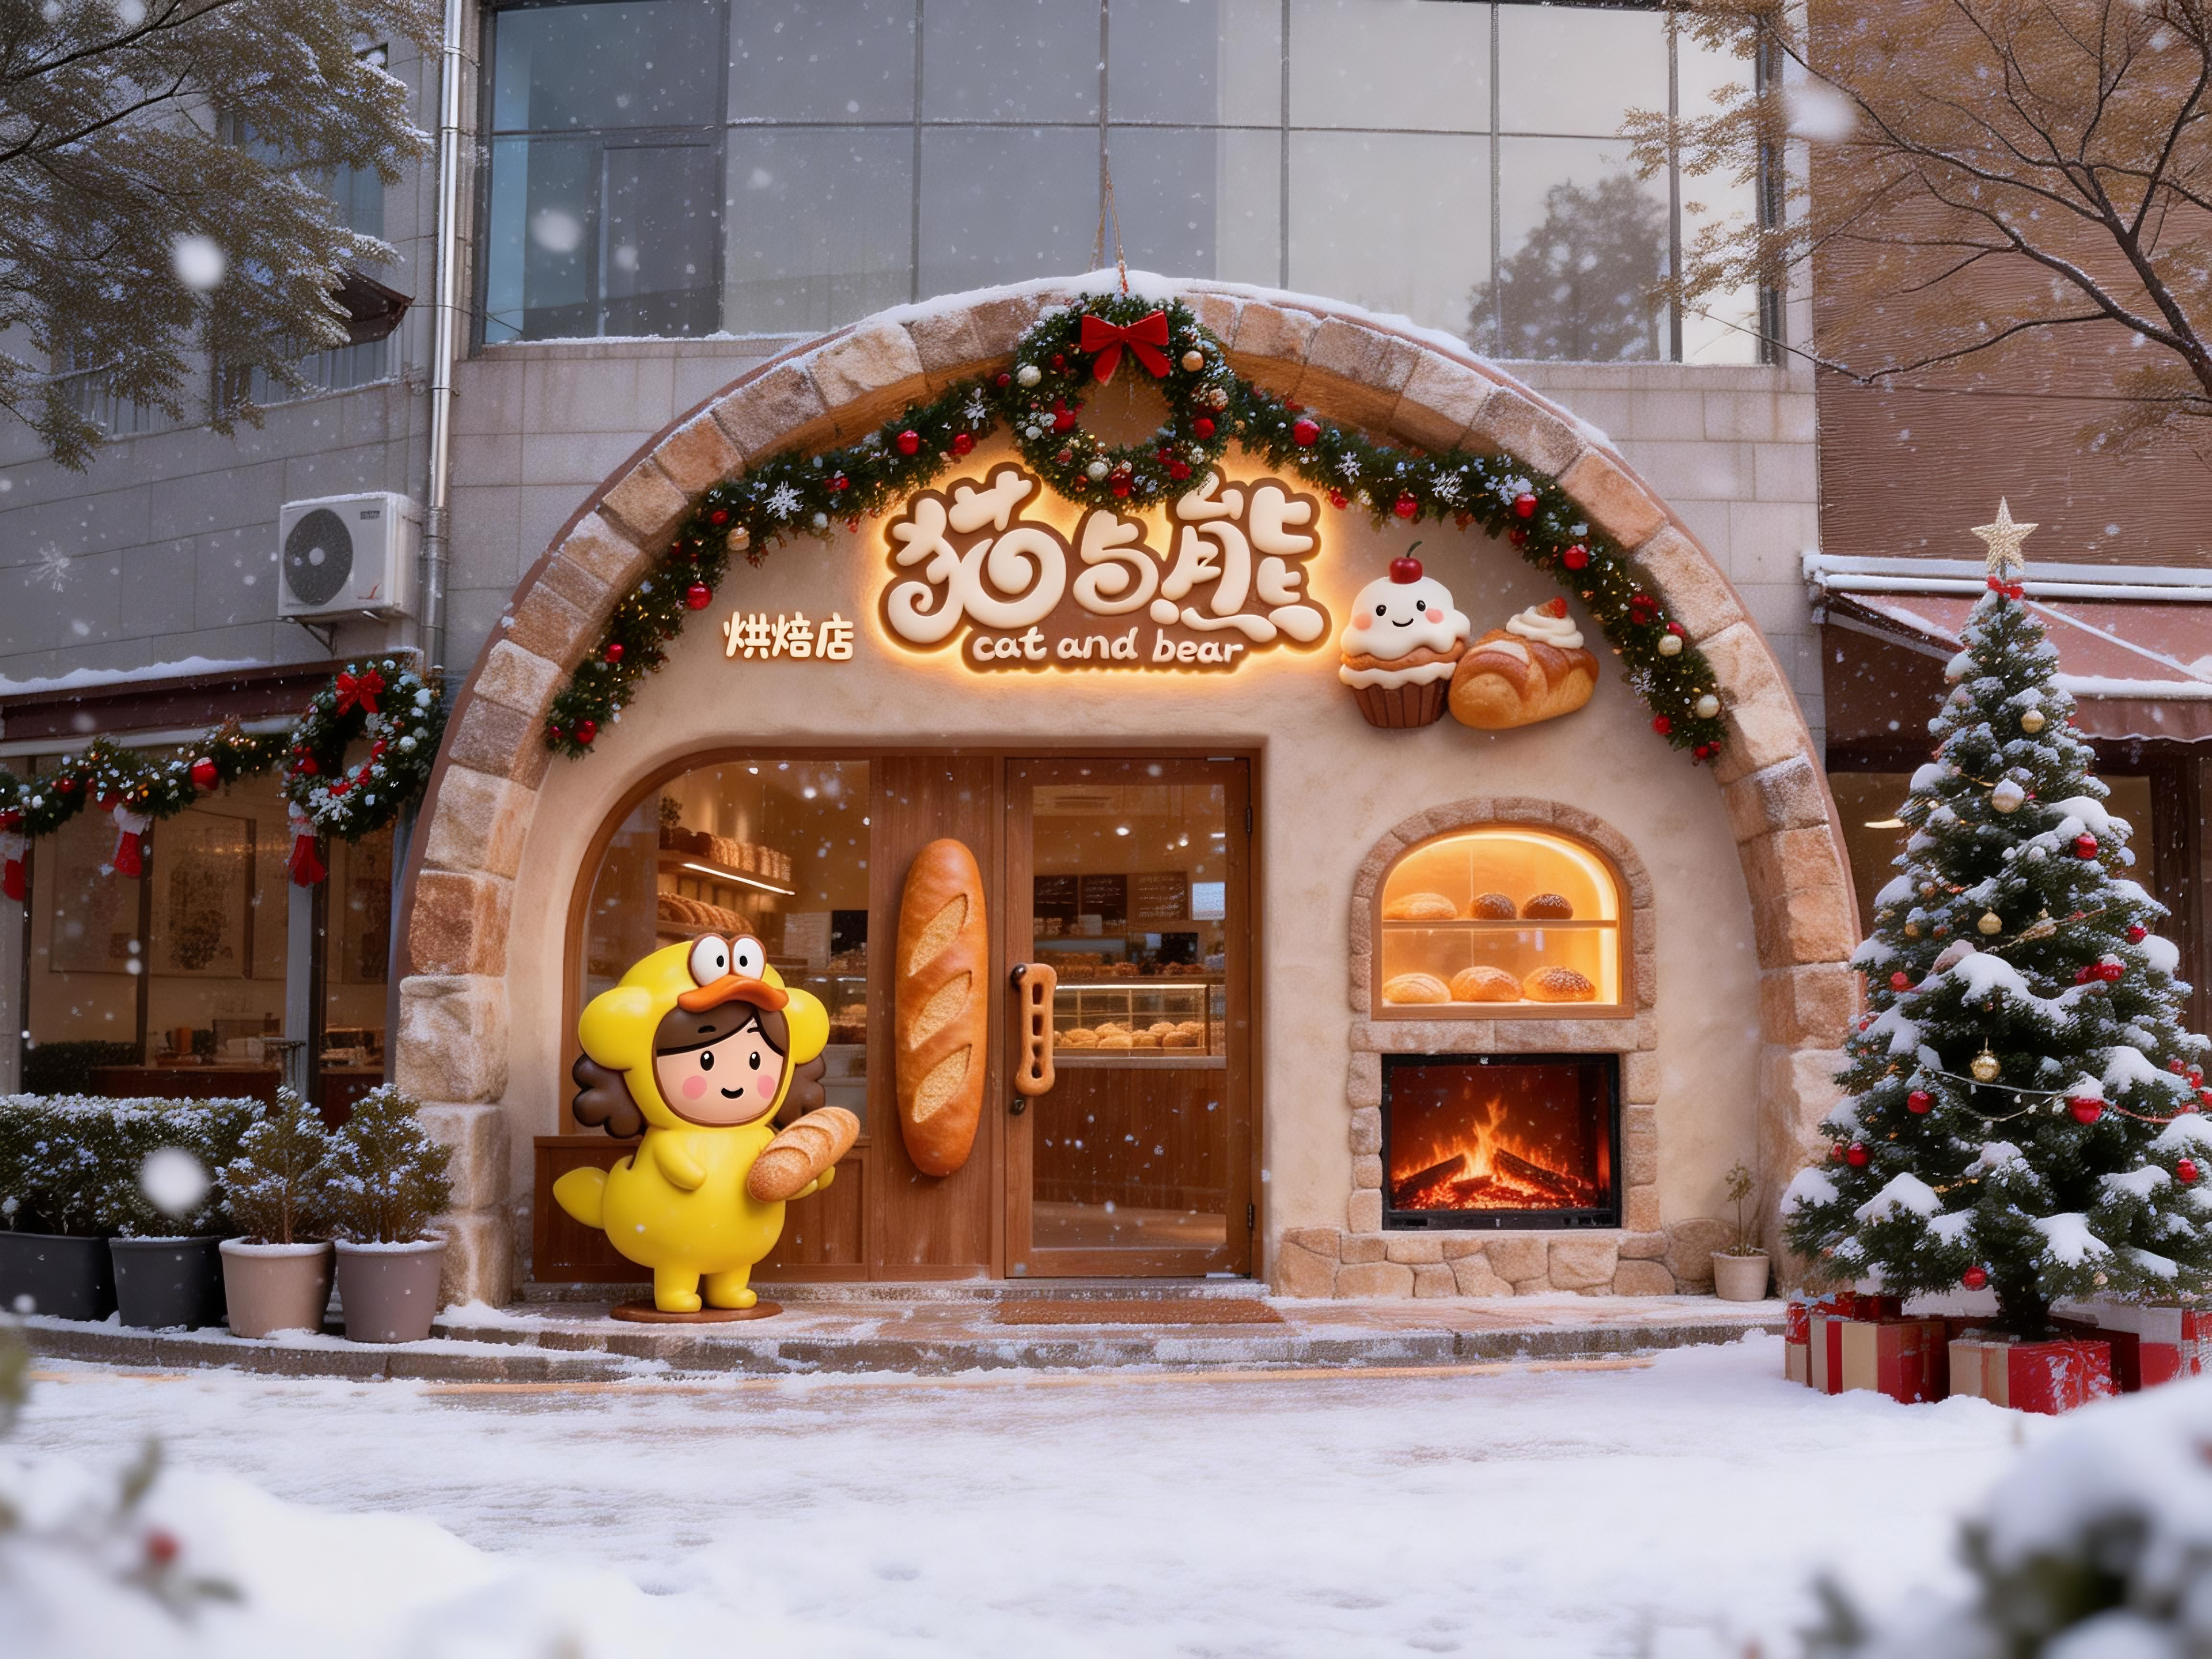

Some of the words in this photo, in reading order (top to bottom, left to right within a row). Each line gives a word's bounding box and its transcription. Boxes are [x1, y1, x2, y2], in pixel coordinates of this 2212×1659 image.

[888, 470, 1324, 643] 猫与熊
[723, 611, 854, 660] 烘焙店
[972, 626, 1048, 661] cat
[1057, 626, 1139, 660] and
[1152, 628, 1244, 664] bear
